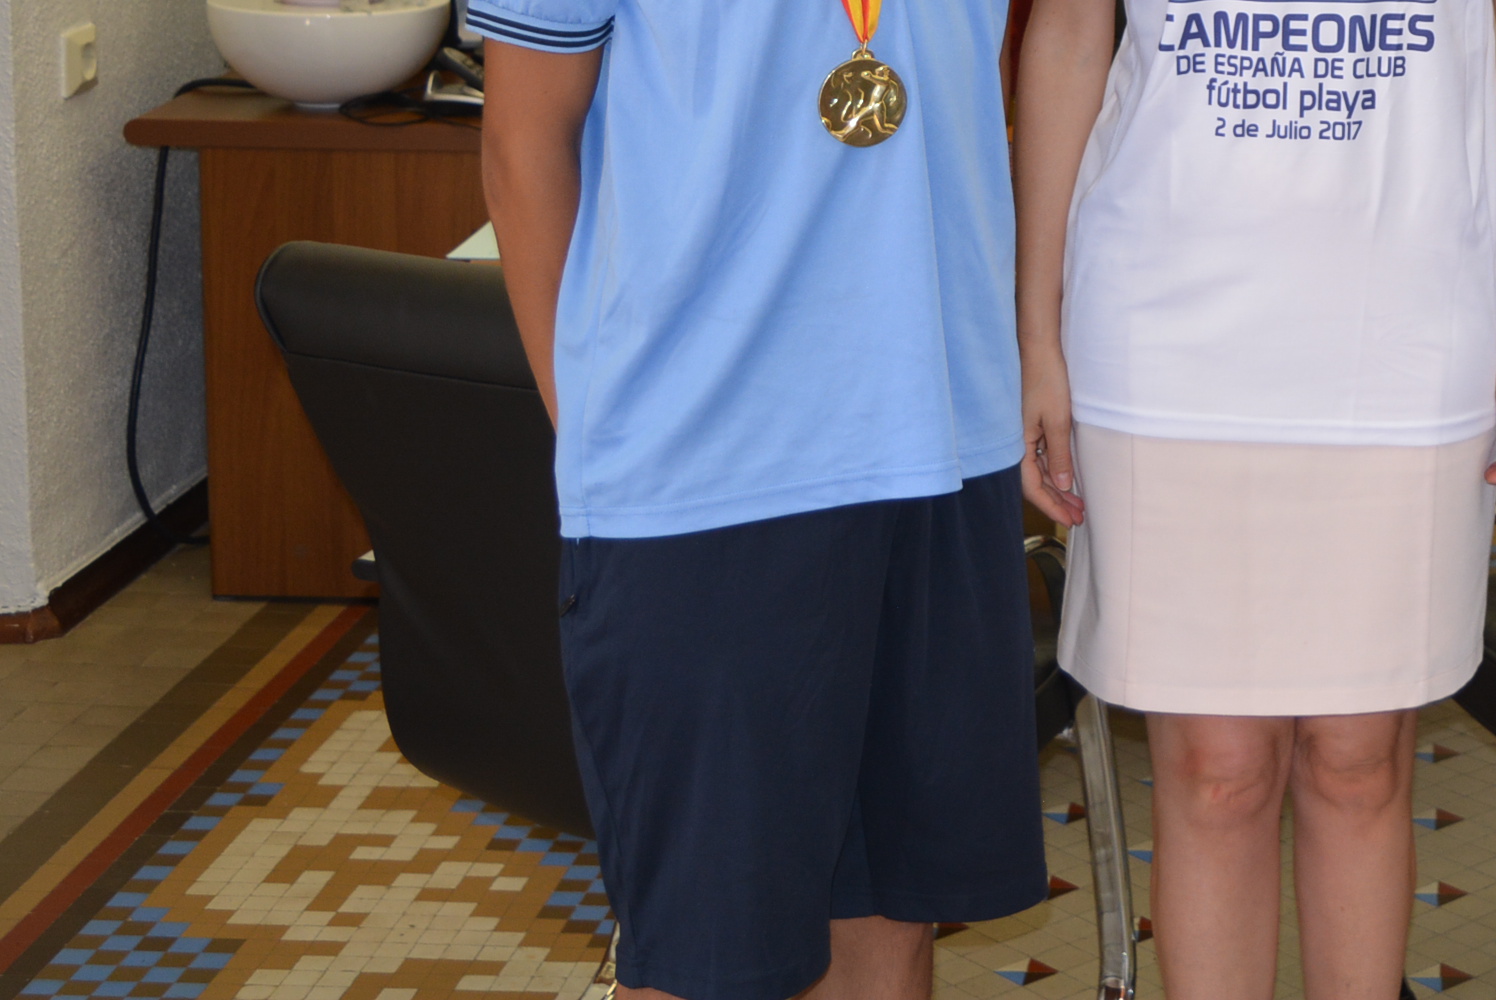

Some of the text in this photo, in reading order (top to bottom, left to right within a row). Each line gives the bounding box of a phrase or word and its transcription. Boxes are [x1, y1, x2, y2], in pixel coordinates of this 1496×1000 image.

[1176, 52, 1406, 79] DE ESPAÑA DE CLUB
[1206, 78, 1376, 119] fútbol playa
[1214, 117, 1363, 141] 2 de Julio 2017
